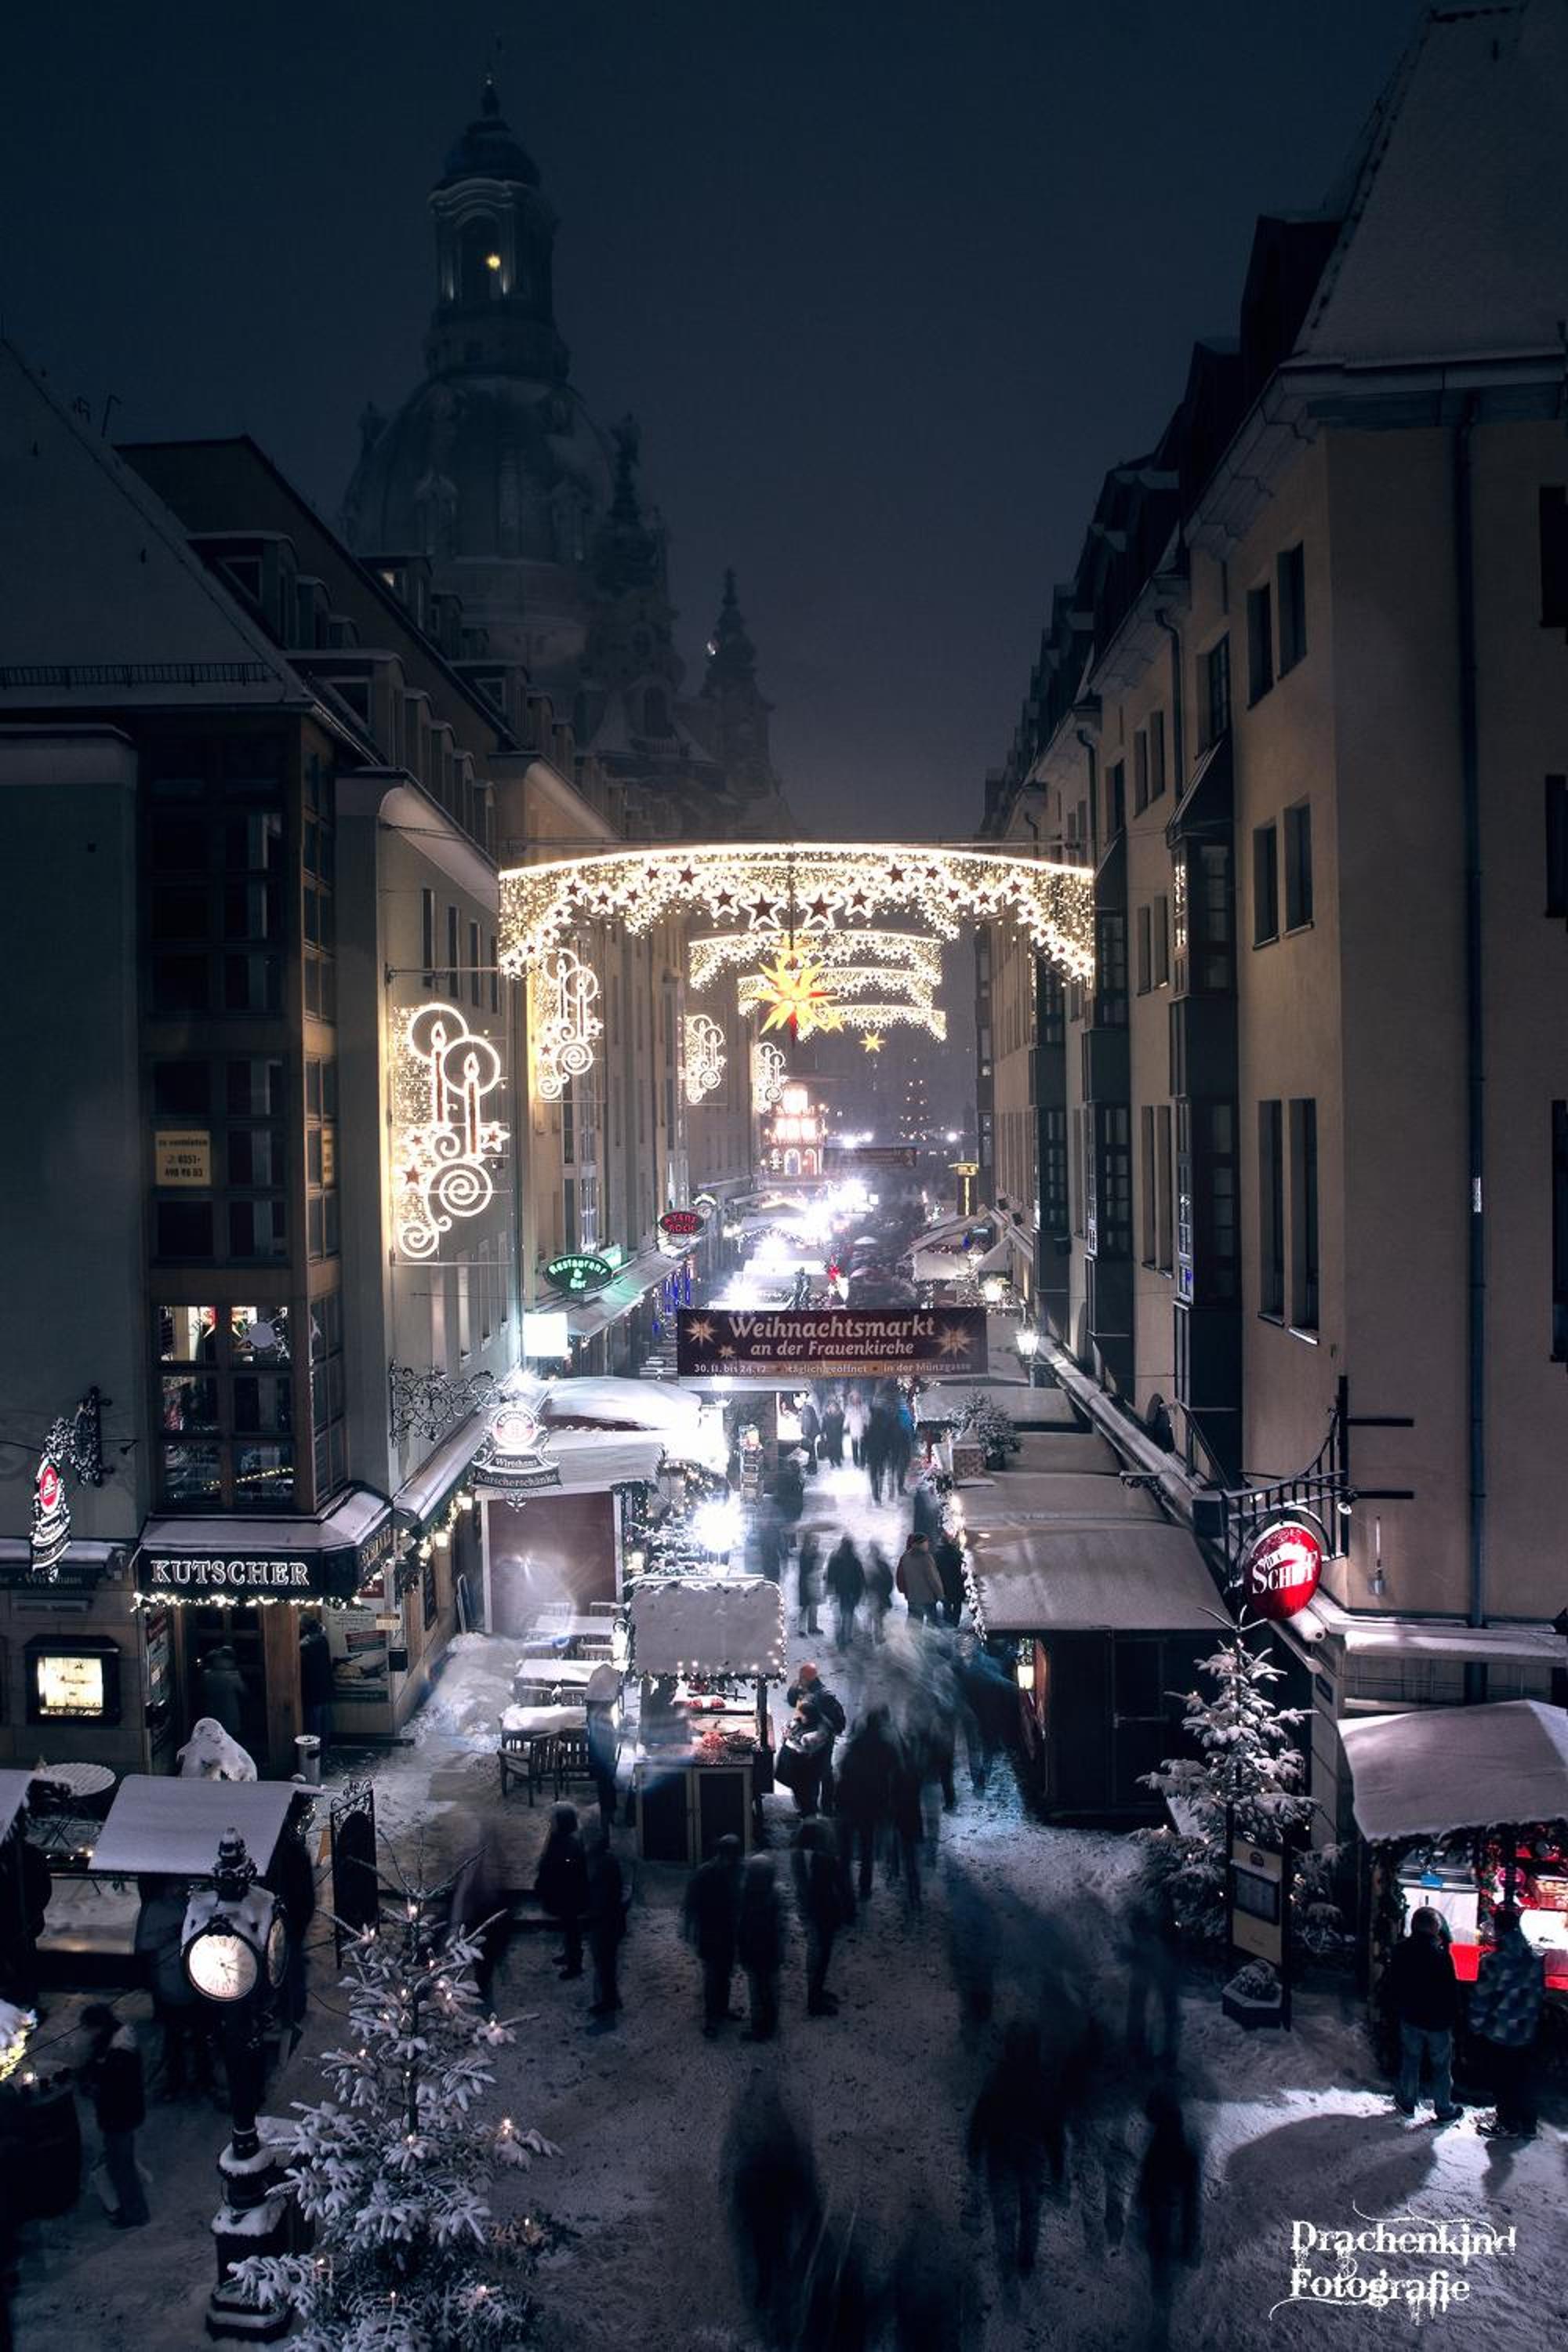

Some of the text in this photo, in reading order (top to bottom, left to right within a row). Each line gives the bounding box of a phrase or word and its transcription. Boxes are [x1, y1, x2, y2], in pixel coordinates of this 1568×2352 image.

[548, 1258, 608, 1276] Restaurant
[728, 1316, 935, 1338] Weihnachtsmarkt
[750, 1338, 915, 1356] an der Frauenkirche
[150, 1559, 310, 1587] KUTSCHER
[1252, 1551, 1318, 1594] SCHF
